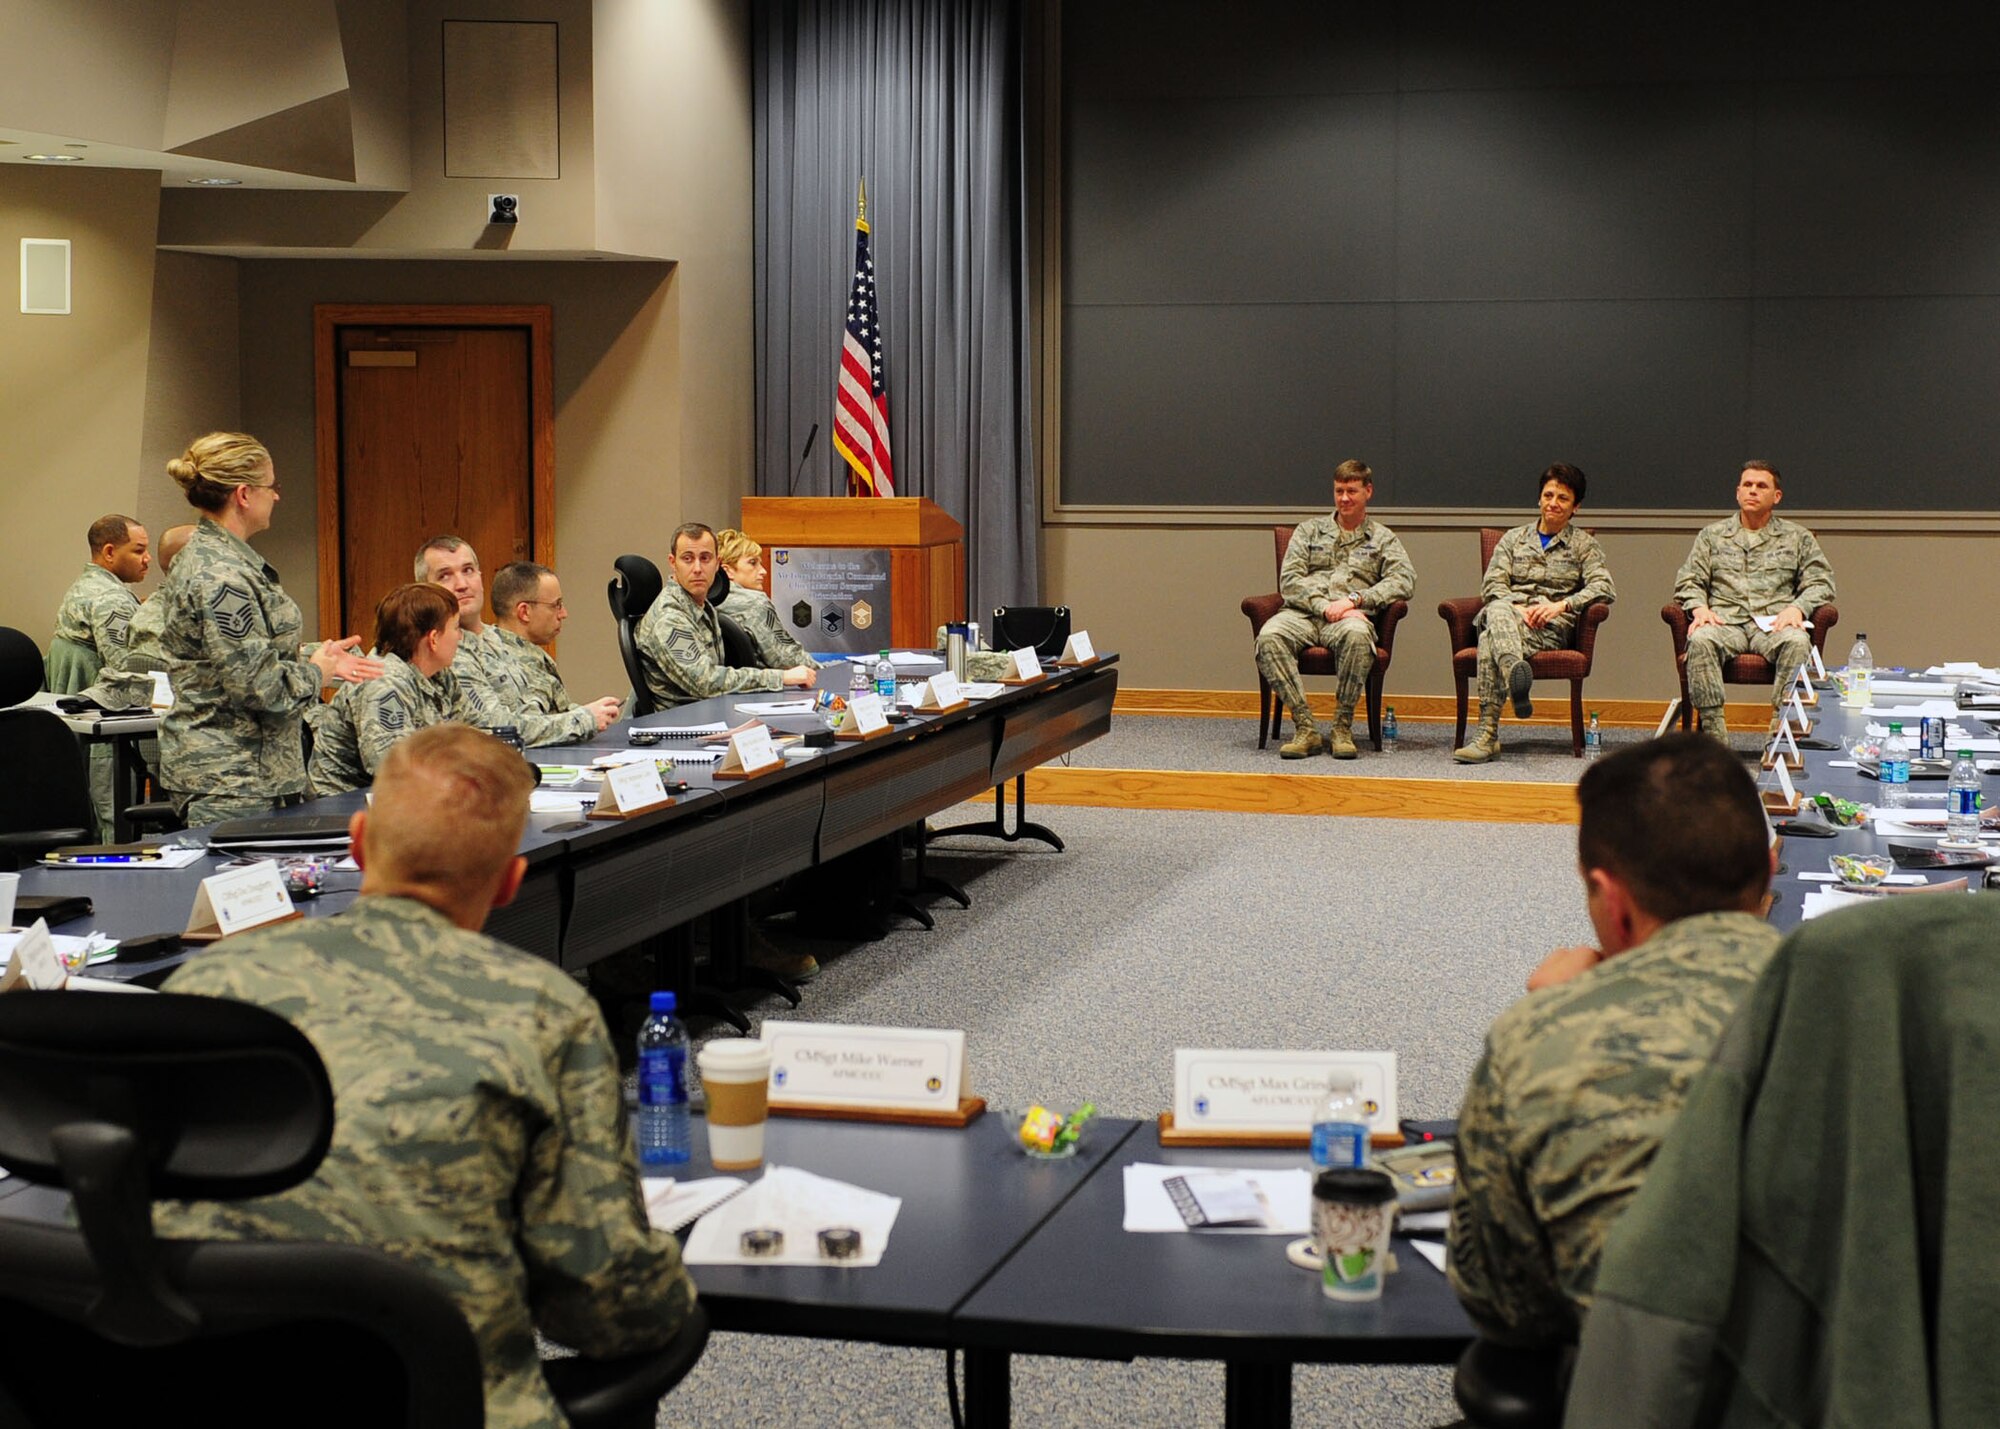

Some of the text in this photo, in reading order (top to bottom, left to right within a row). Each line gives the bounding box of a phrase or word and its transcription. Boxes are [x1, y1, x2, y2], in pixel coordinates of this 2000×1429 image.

[794, 1049, 925, 1067] CMSgt Mike Warner
[1207, 1076, 1255, 1094] CMSgt
[1260, 1077, 1290, 1090] Max
